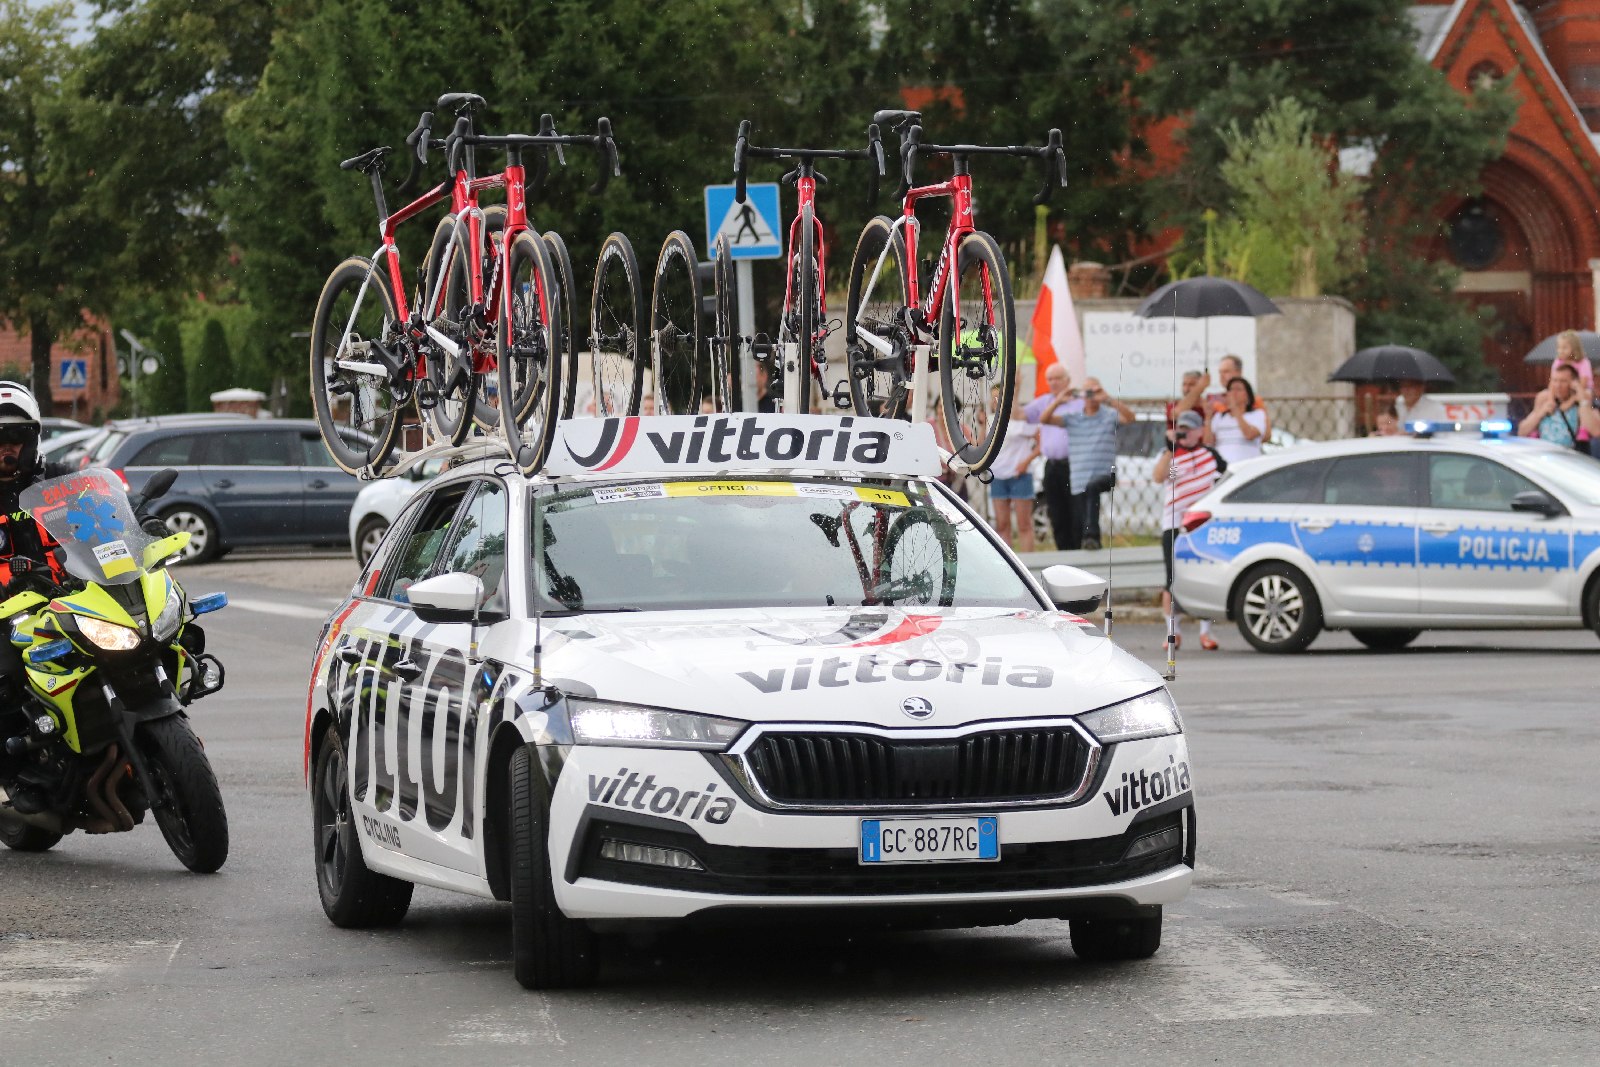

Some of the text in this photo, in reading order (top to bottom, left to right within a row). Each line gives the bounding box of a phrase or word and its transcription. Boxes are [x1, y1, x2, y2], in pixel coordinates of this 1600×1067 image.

[1089, 323, 1178, 335] LOGOPEDA
[646, 415, 891, 464] vittoria
[1458, 535, 1550, 562] POLICJA
[735, 655, 1055, 693] vittoria
[588, 767, 737, 825] vittoria
[1102, 754, 1191, 817] vittoria
[363, 814, 402, 849] CYCLING
